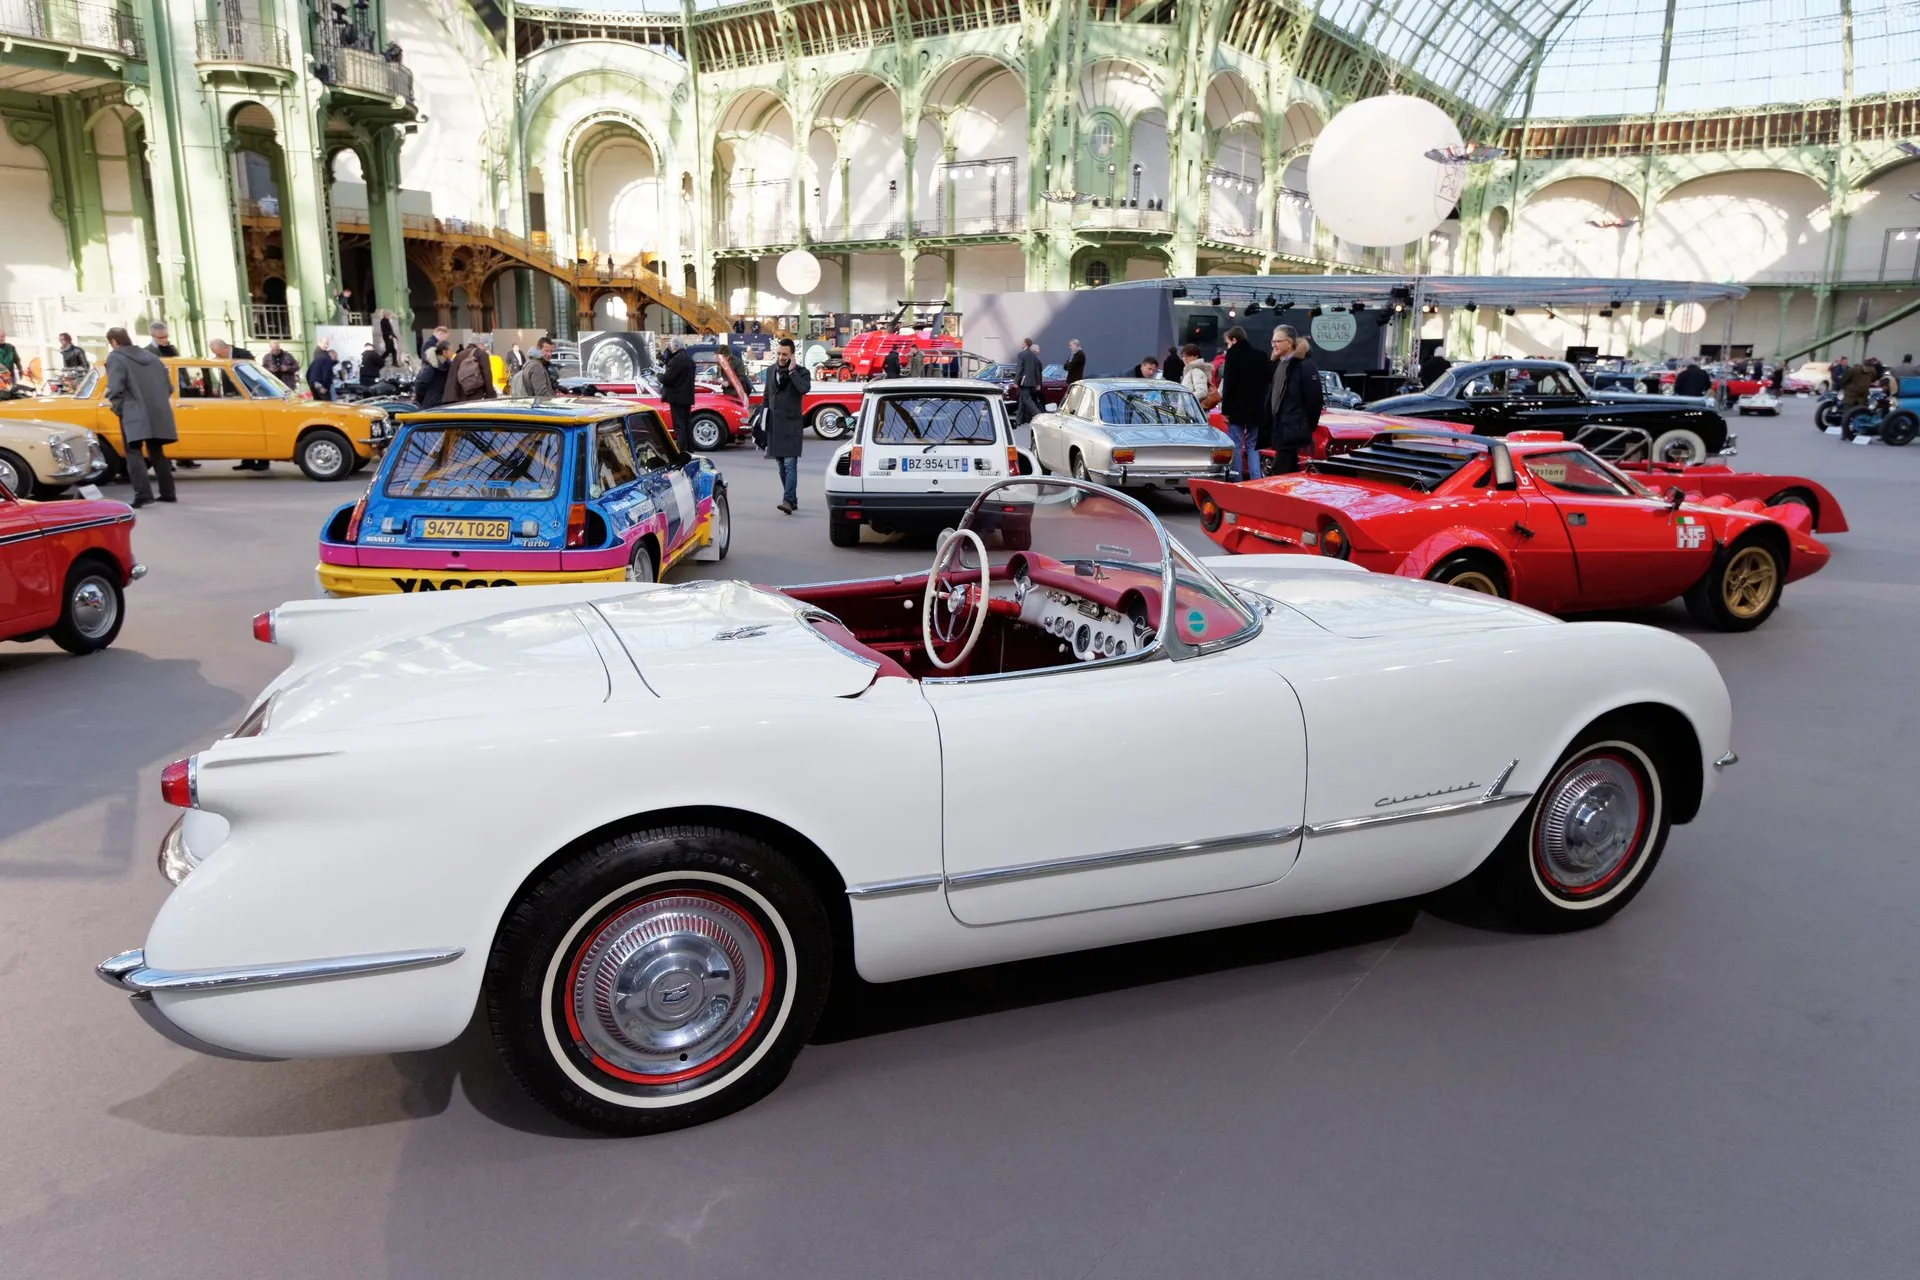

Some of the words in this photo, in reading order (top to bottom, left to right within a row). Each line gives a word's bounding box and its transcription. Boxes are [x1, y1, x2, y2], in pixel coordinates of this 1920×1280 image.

[1316, 321, 1351, 331] GRAND
[1316, 331, 1351, 340] PALAIS
[908, 458, 959, 469] BZ-954-LT
[427, 521, 464, 536] 9474
[1676, 526, 1706, 549] HF
[521, 539, 550, 548] Turbo
